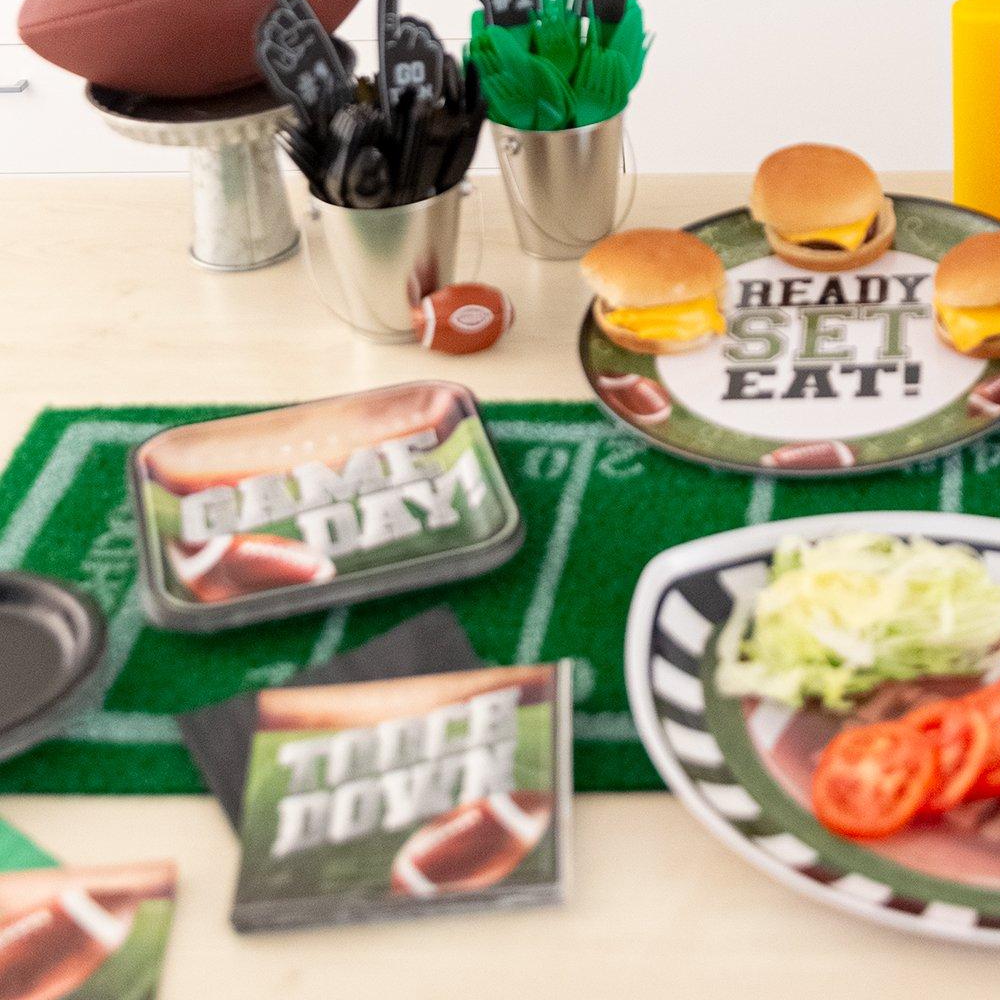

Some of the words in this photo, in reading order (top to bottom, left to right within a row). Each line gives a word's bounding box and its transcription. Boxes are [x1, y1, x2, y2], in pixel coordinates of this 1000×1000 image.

[722, 303, 932, 363] SET
[737, 273, 932, 309] READY
[722, 363, 923, 402] EAT!
[180, 428, 439, 542] GAME
[299, 448, 487, 559] DAY!
[278, 686, 523, 797] TOUCH
[271, 740, 520, 860] DOWN
